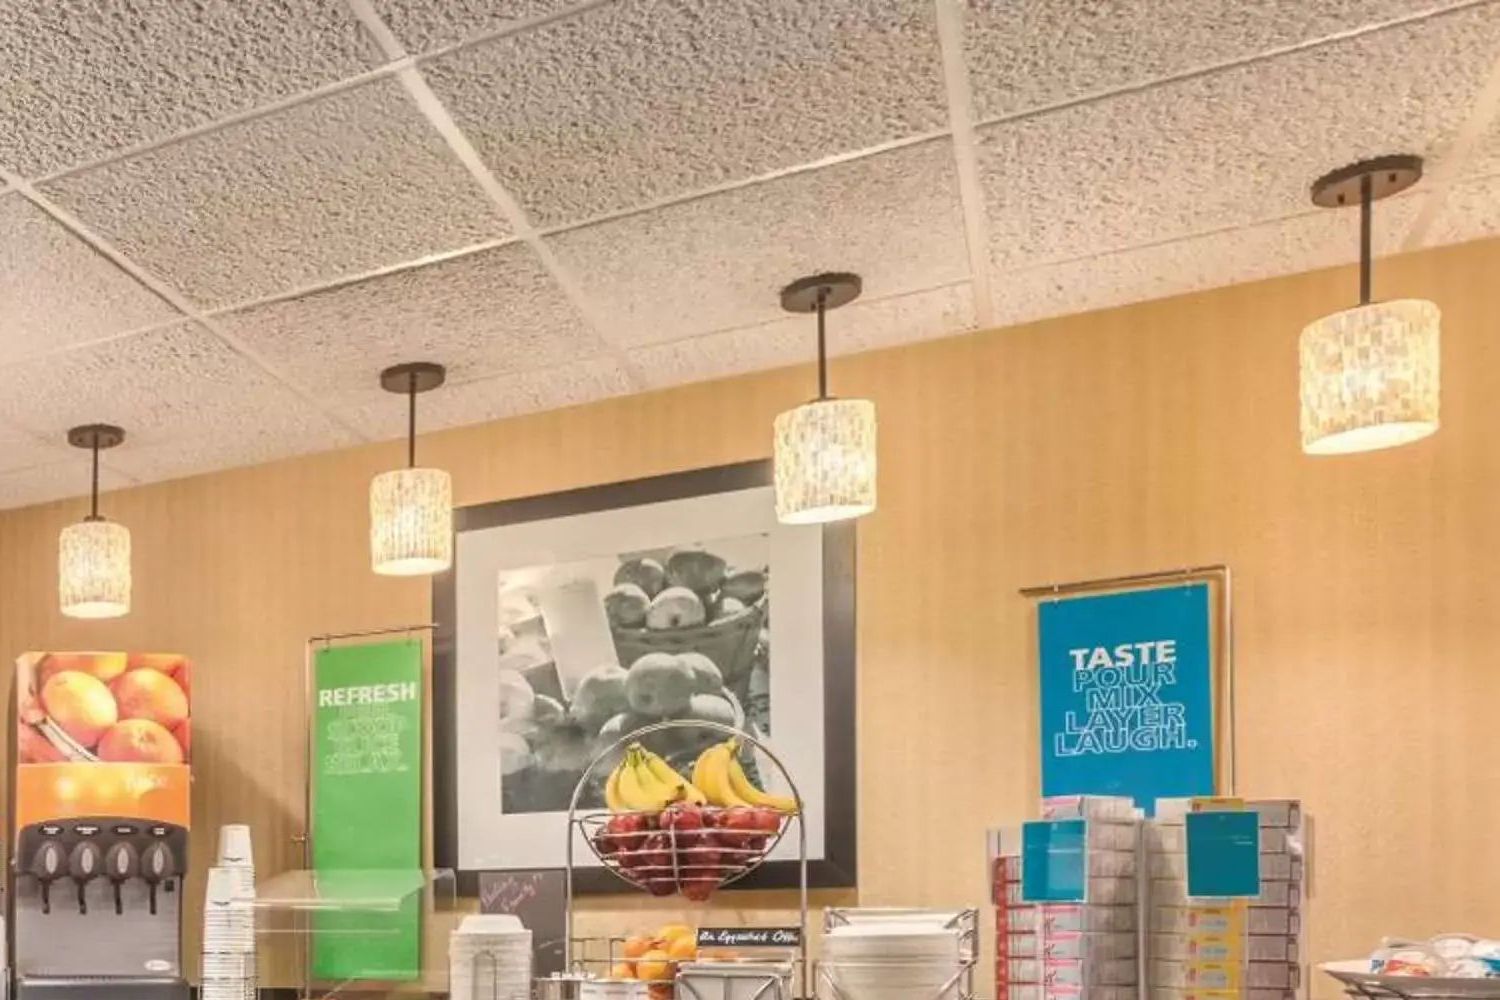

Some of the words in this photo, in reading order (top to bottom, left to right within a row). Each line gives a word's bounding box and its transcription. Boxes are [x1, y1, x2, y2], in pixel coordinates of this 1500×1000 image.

[1069, 639, 1177, 671] TASTE
[1073, 662, 1177, 693] POUR
[319, 681, 417, 707] REFRESH
[1086, 684, 1163, 712] MIX
[1065, 703, 1186, 735] LAYER
[1055, 726, 1198, 758] LAUGH.
